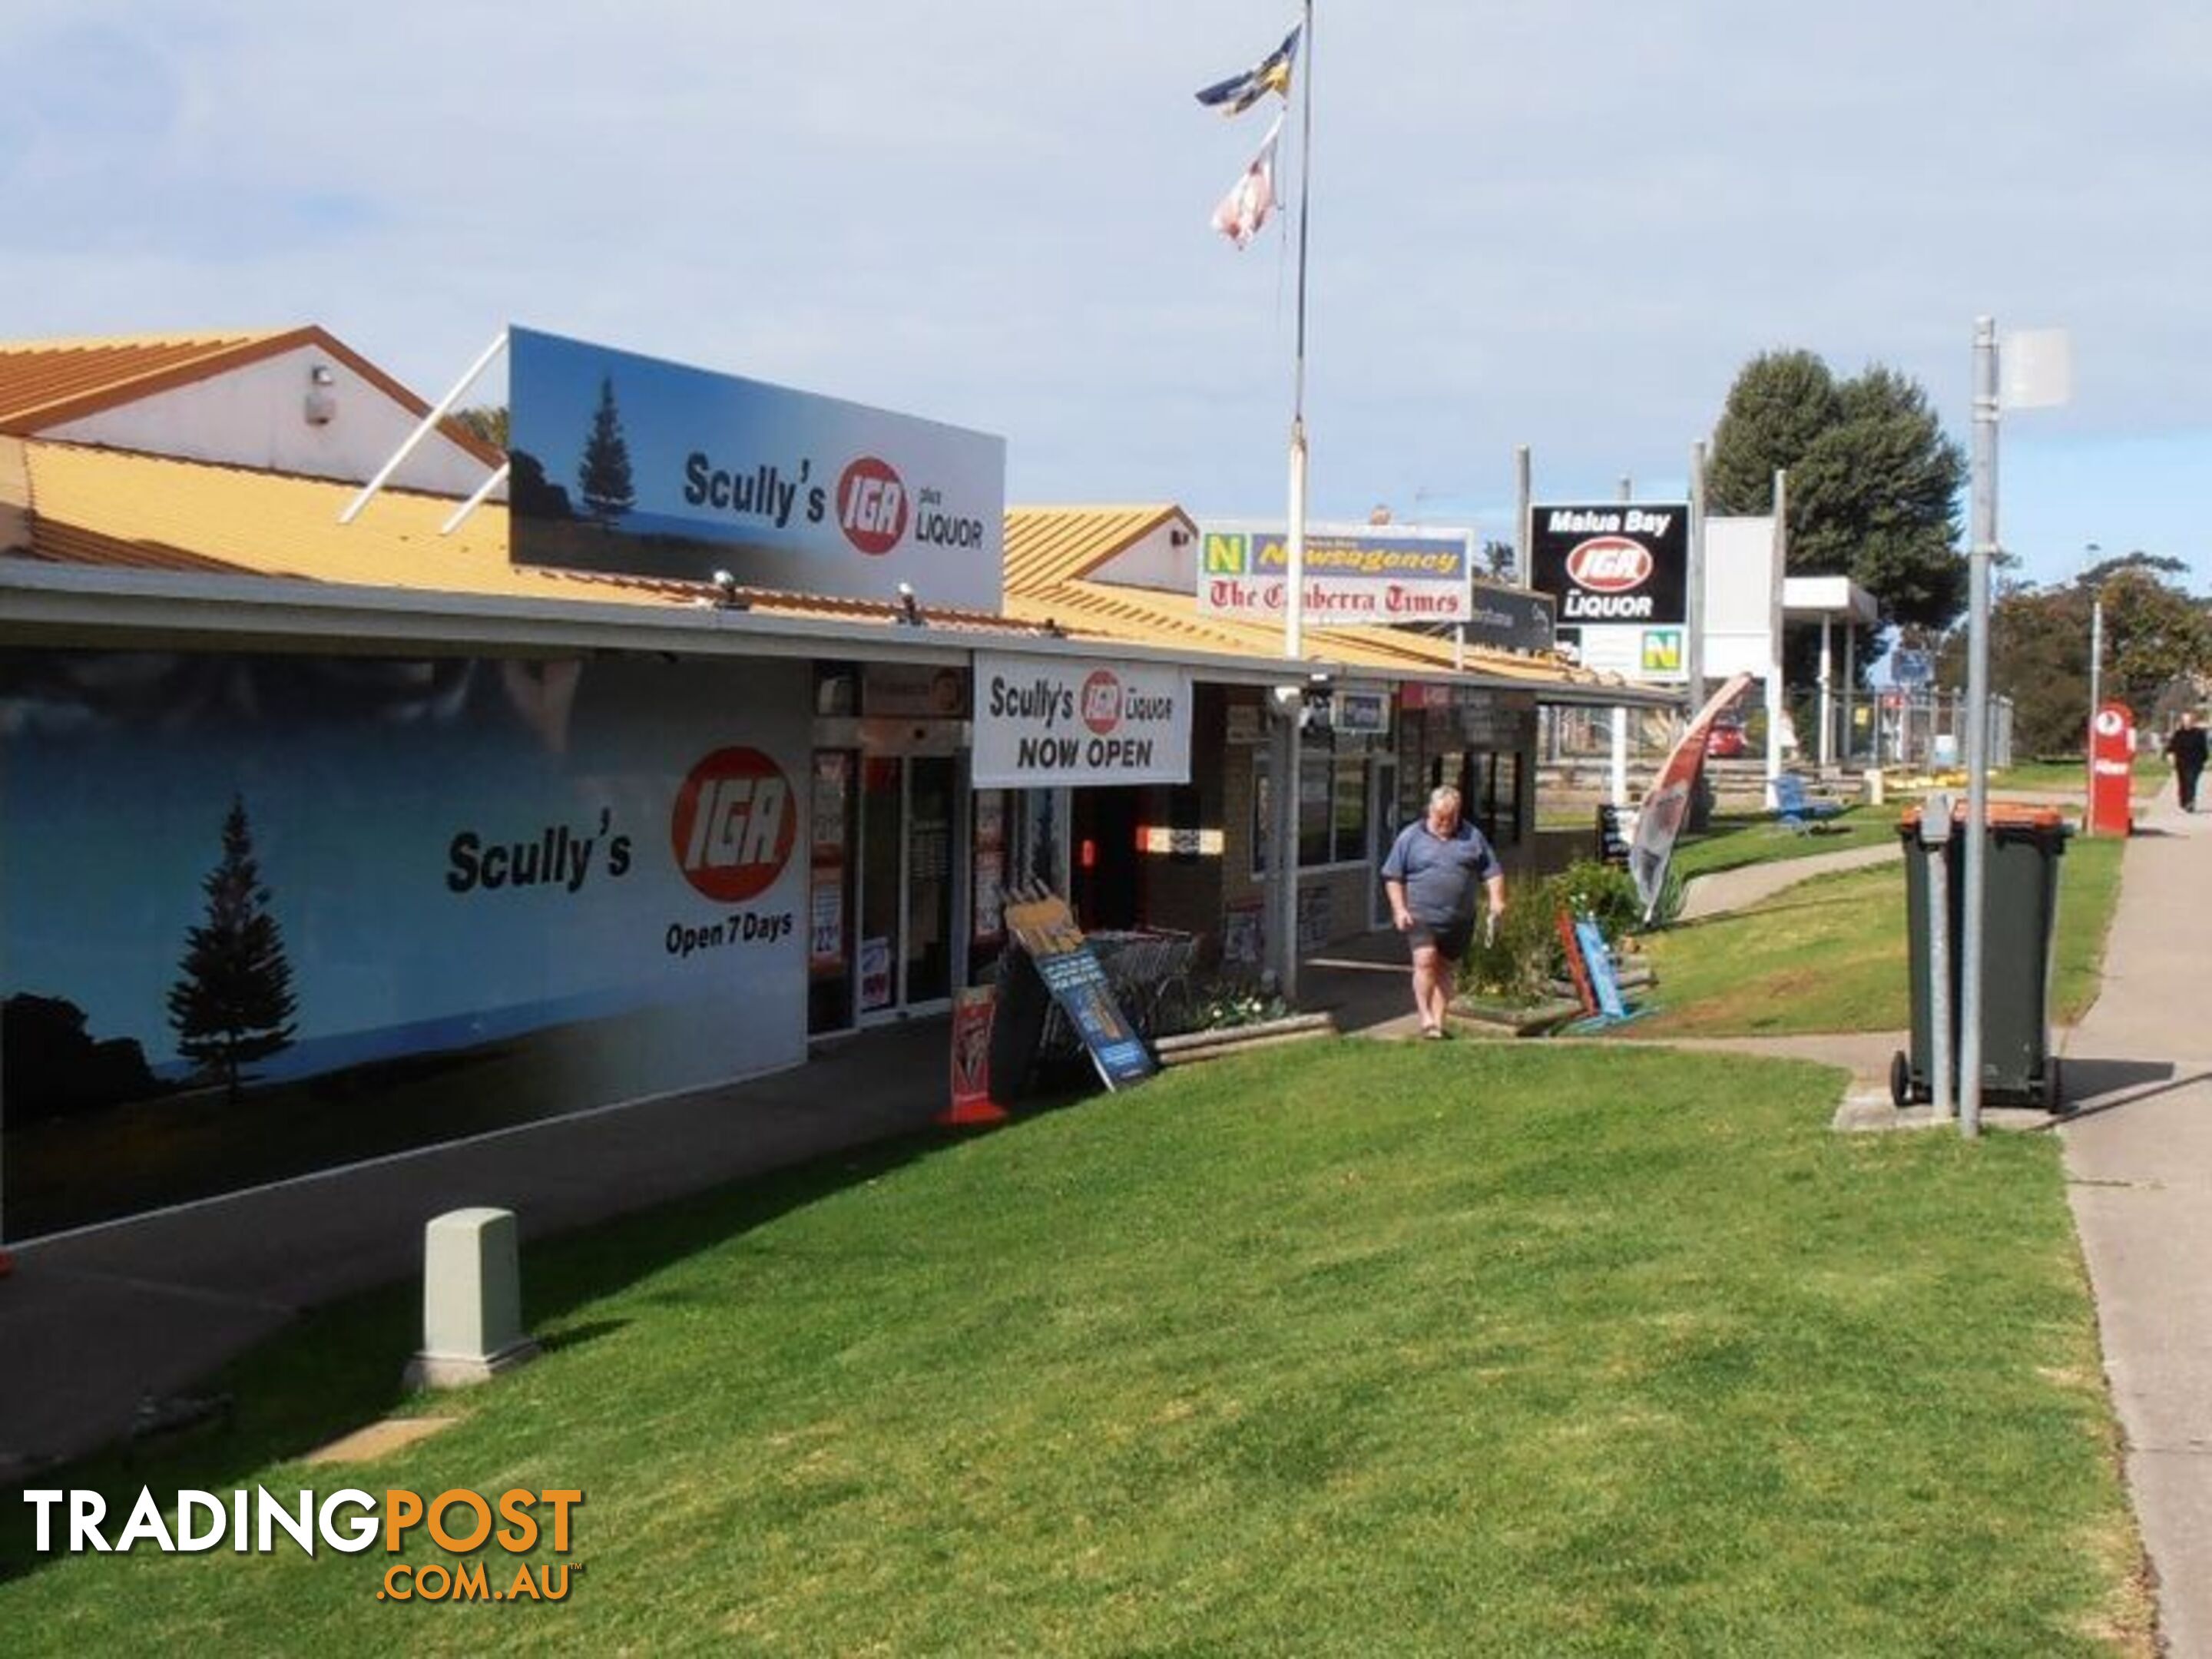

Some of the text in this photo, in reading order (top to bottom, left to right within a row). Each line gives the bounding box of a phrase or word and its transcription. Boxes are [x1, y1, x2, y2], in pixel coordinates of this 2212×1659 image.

[684, 452, 825, 528] Scully's
[843, 476, 900, 536] IGA
[916, 511, 983, 549] LIQUOR
[1548, 510, 1672, 537] Malua Bay
[1208, 536, 1240, 571] N
[1258, 542, 1459, 575] Nwsagency
[1575, 548, 1642, 579] IGA
[1211, 581, 1459, 612] The Cnberra Times
[1564, 594, 1654, 616] LIQUOR
[989, 676, 1074, 728] Scully's
[1018, 738, 1154, 768] NOW OPEN
[684, 777, 788, 871] IGA
[447, 806, 631, 894] Scully's
[665, 912, 793, 958] Open 7 Days
